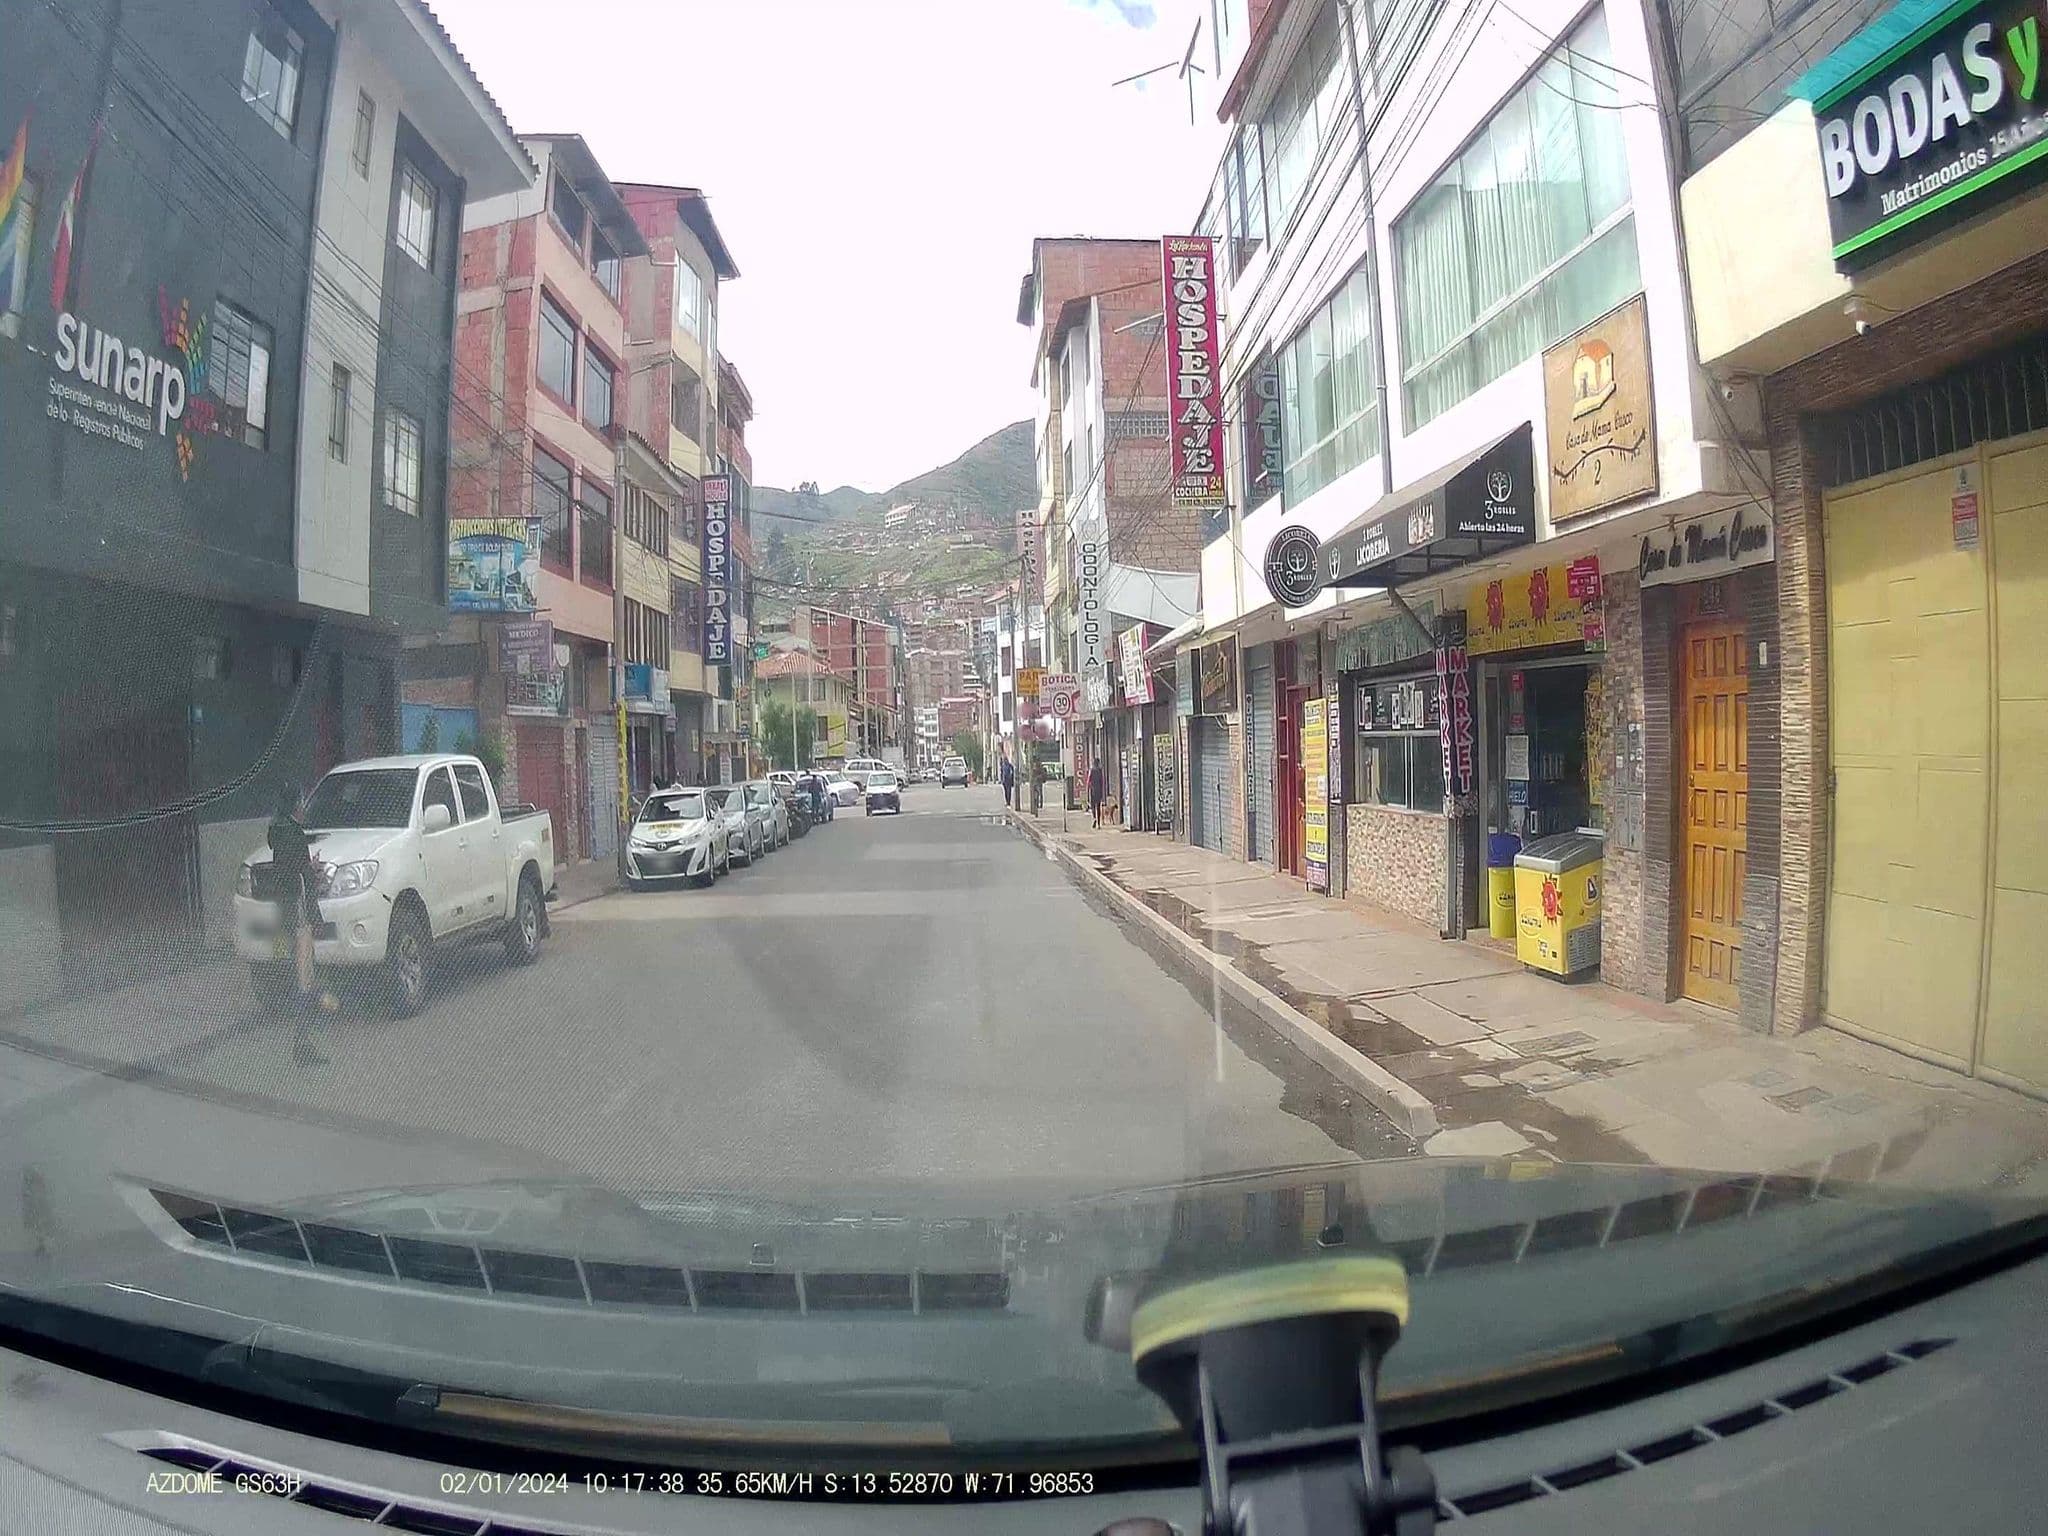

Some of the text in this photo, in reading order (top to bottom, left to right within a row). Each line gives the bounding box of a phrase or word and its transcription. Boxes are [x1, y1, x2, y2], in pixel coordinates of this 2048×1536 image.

[1820, 22, 2004, 198] BODAS
[1881, 147, 1987, 216] Matrimonios
[55, 312, 186, 436] sunarp
[1170, 256, 1217, 474] HOSPEDAJE
[47, 398, 59, 418] de
[59, 402, 72, 423] lo
[73, 409, 111, 438] Registros
[49, 376, 152, 431] Superintenencia Nacional
[1210, 476, 1222, 490] 24
[1594, 459, 1601, 485] 2
[1459, 521, 1525, 533] Abierto las 24 horas
[1485, 500, 1494, 519] 3
[706, 502, 727, 660] HOSPEDAJE
[1082, 542, 1099, 667] ODONTOLOGIA
[1286, 570, 1294, 586] 3
[1041, 675, 1077, 686] BOTICA
[1055, 697, 1068, 708] 30
[1435, 646, 1451, 797] MARKET
[1449, 645, 1474, 794] MARKET
